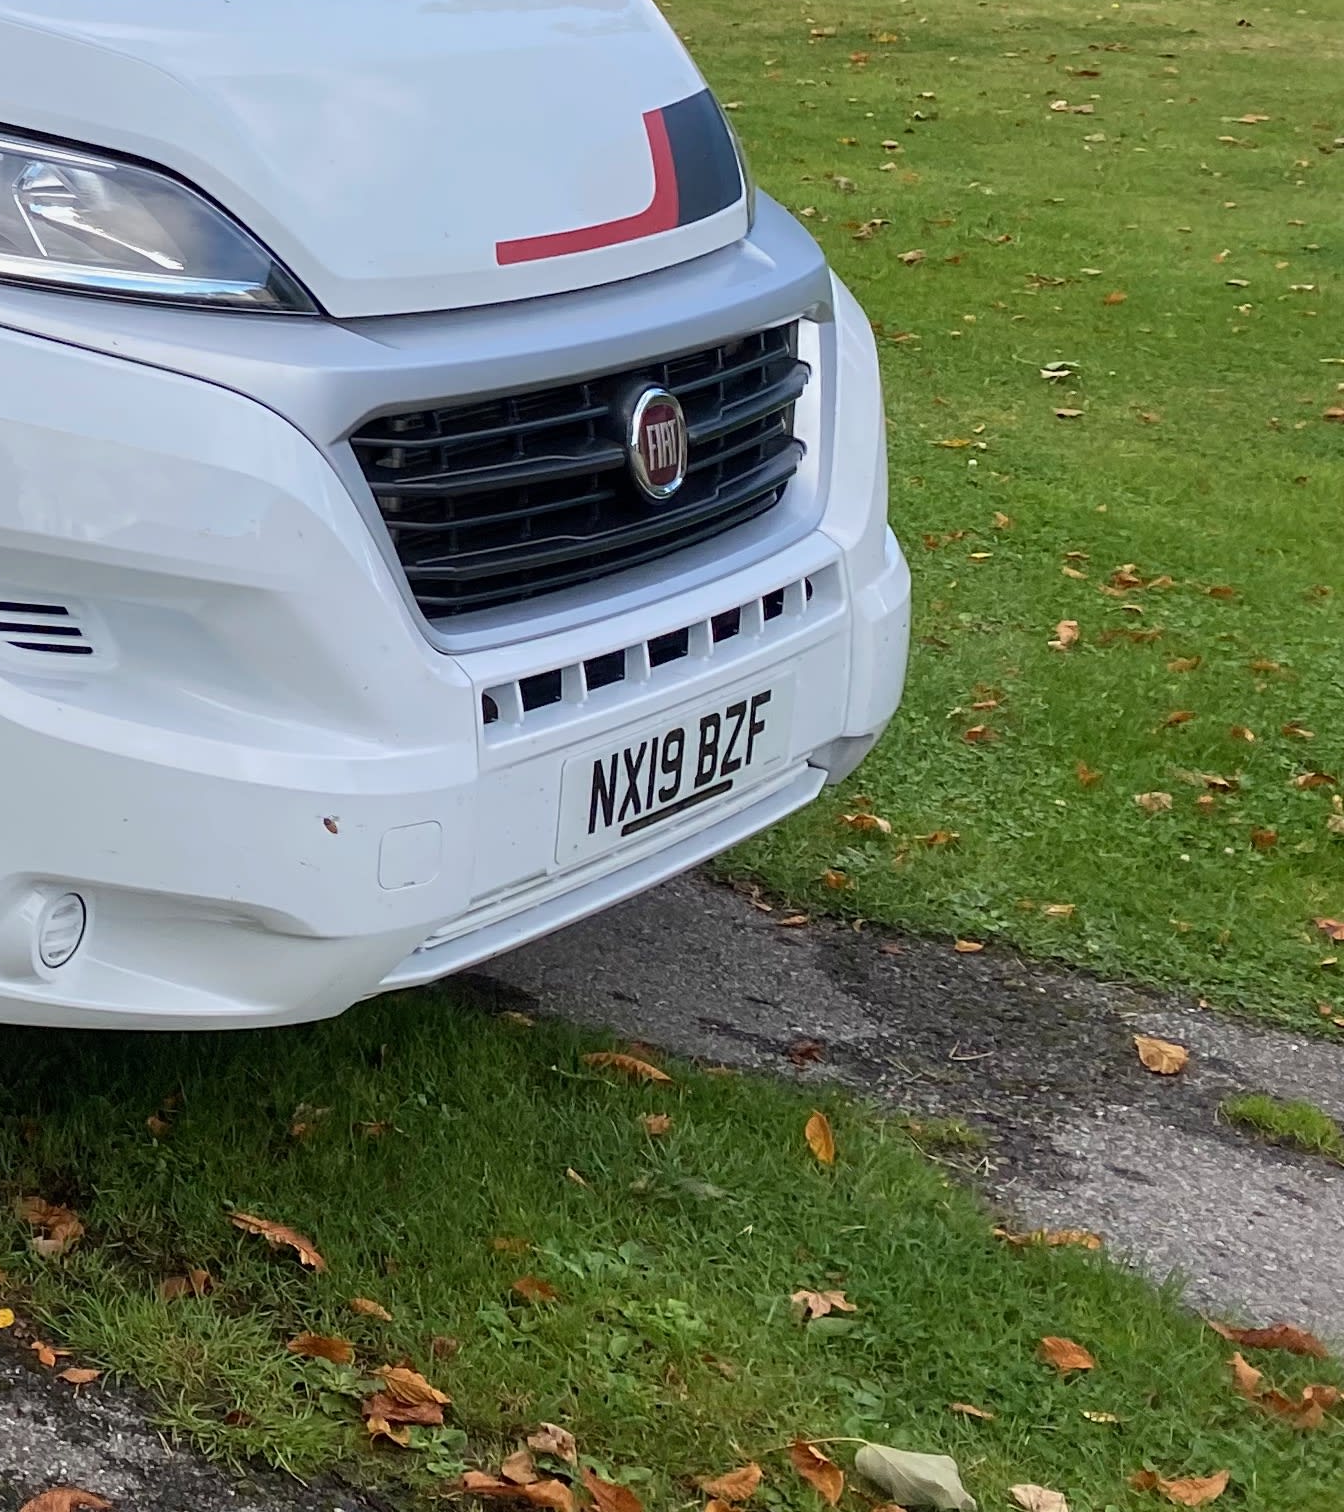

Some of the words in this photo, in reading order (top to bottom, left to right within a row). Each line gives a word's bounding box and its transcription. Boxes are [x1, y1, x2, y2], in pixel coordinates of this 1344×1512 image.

[646, 418, 678, 472] FIAT
[587, 728, 685, 835] NX19
[694, 689, 772, 790] BZF
